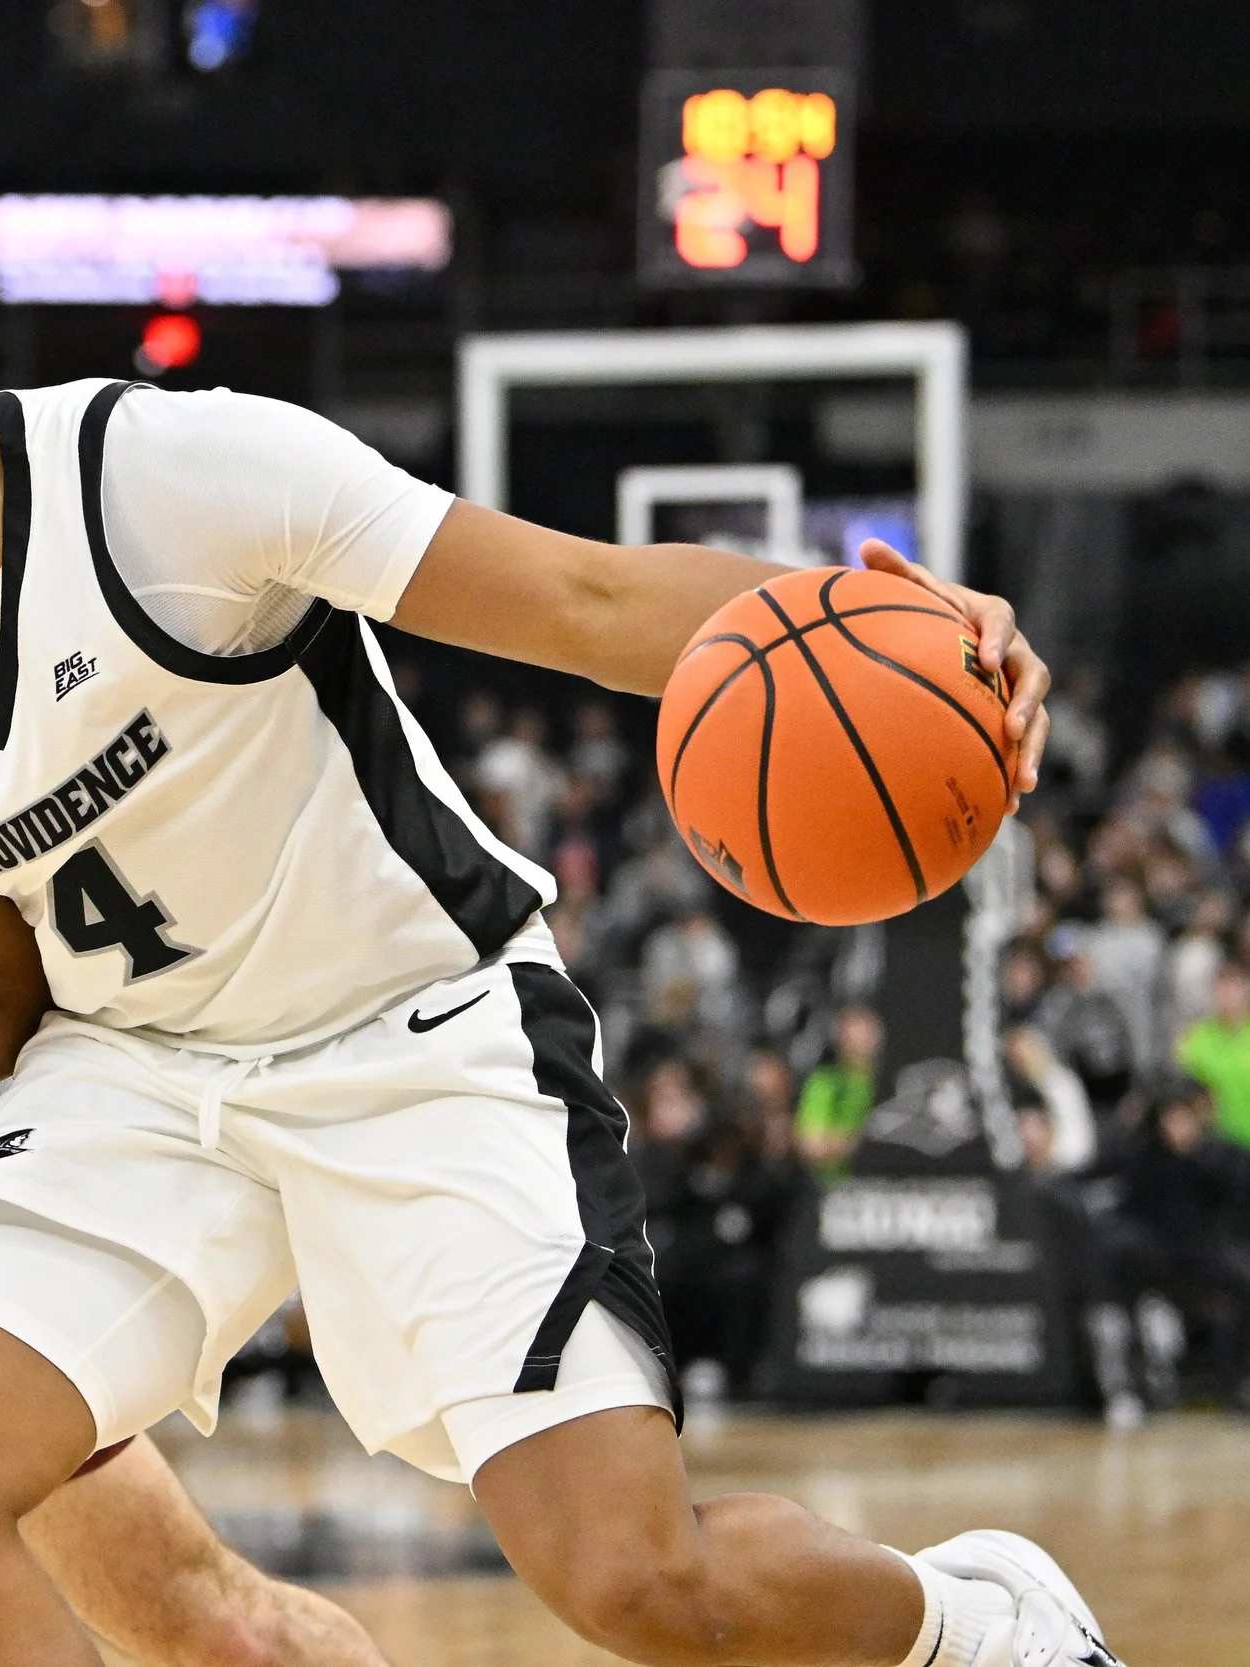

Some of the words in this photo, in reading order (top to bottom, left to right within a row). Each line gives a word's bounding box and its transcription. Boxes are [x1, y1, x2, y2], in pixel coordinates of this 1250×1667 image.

[54, 651, 83, 680] BIG
[56, 657, 97, 694] EAST
[47, 837, 206, 986] 4
